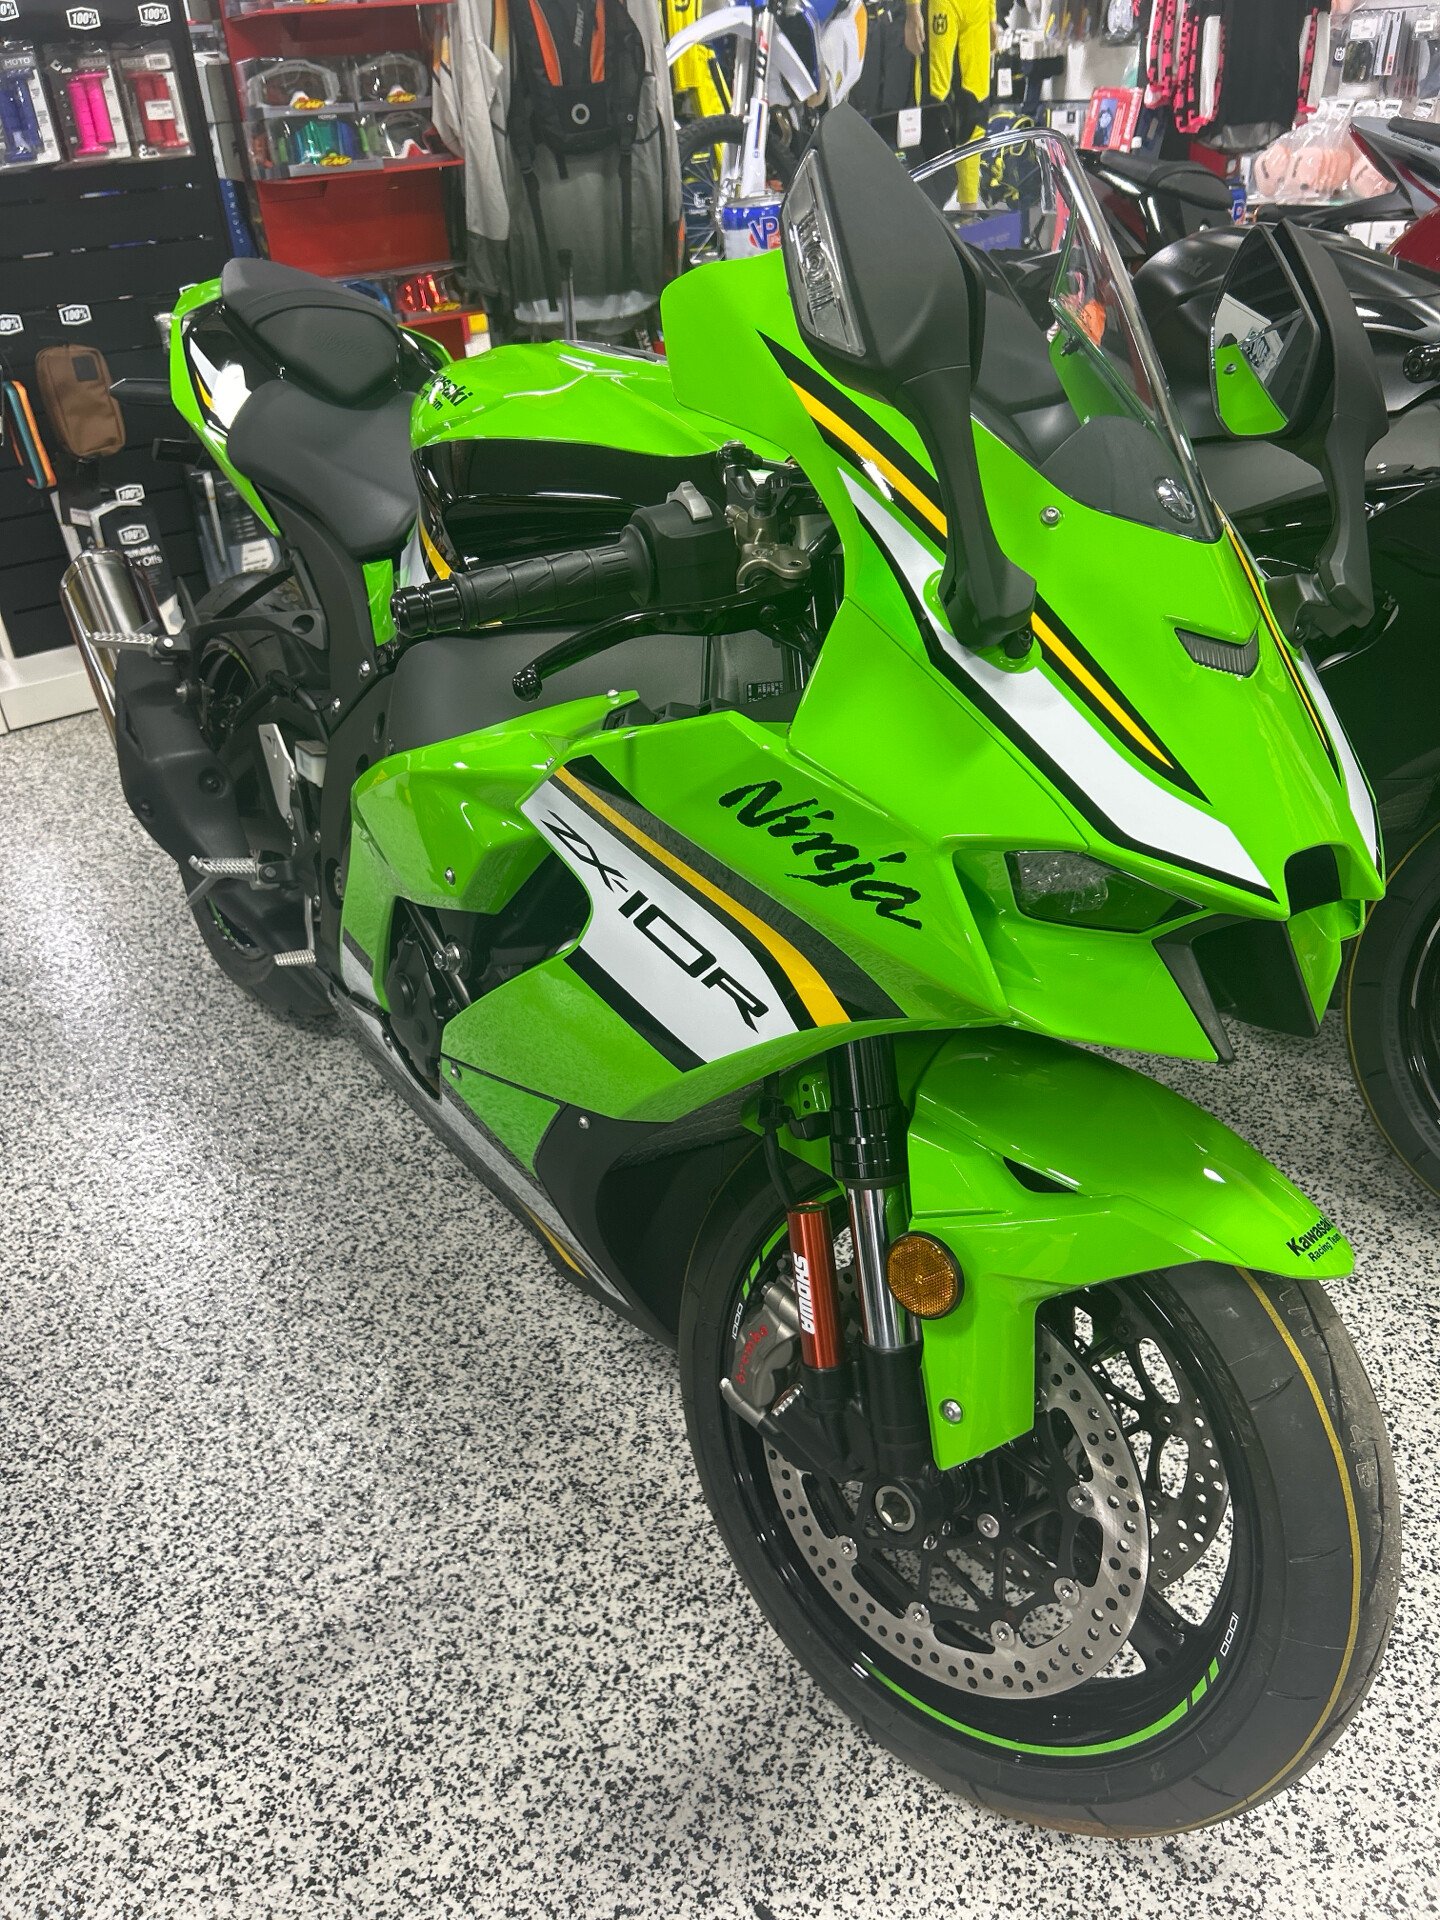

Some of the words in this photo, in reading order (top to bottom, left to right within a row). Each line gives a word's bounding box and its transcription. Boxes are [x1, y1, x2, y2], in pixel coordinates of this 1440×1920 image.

[0, 2, 15, 16] 0%
[71, 12, 97, 25] 100%
[143, 8, 167, 20] 100%
[4, 57, 31, 67] MOTO
[748, 216, 780, 250] VP
[0, 318, 19, 331] 00%
[64, 308, 88, 321] 100%
[718, 780, 922, 930] Ninja
[540, 810, 769, 1034] ZX-10R
[1307, 1242, 1334, 1263] Racing
[1326, 1233, 1342, 1246] Team
[793, 1251, 816, 1335] SHOWA
[731, 1302, 744, 1340] 1000
[735, 1323, 769, 1385] brembo
[1219, 1611, 1240, 1657] 1000
